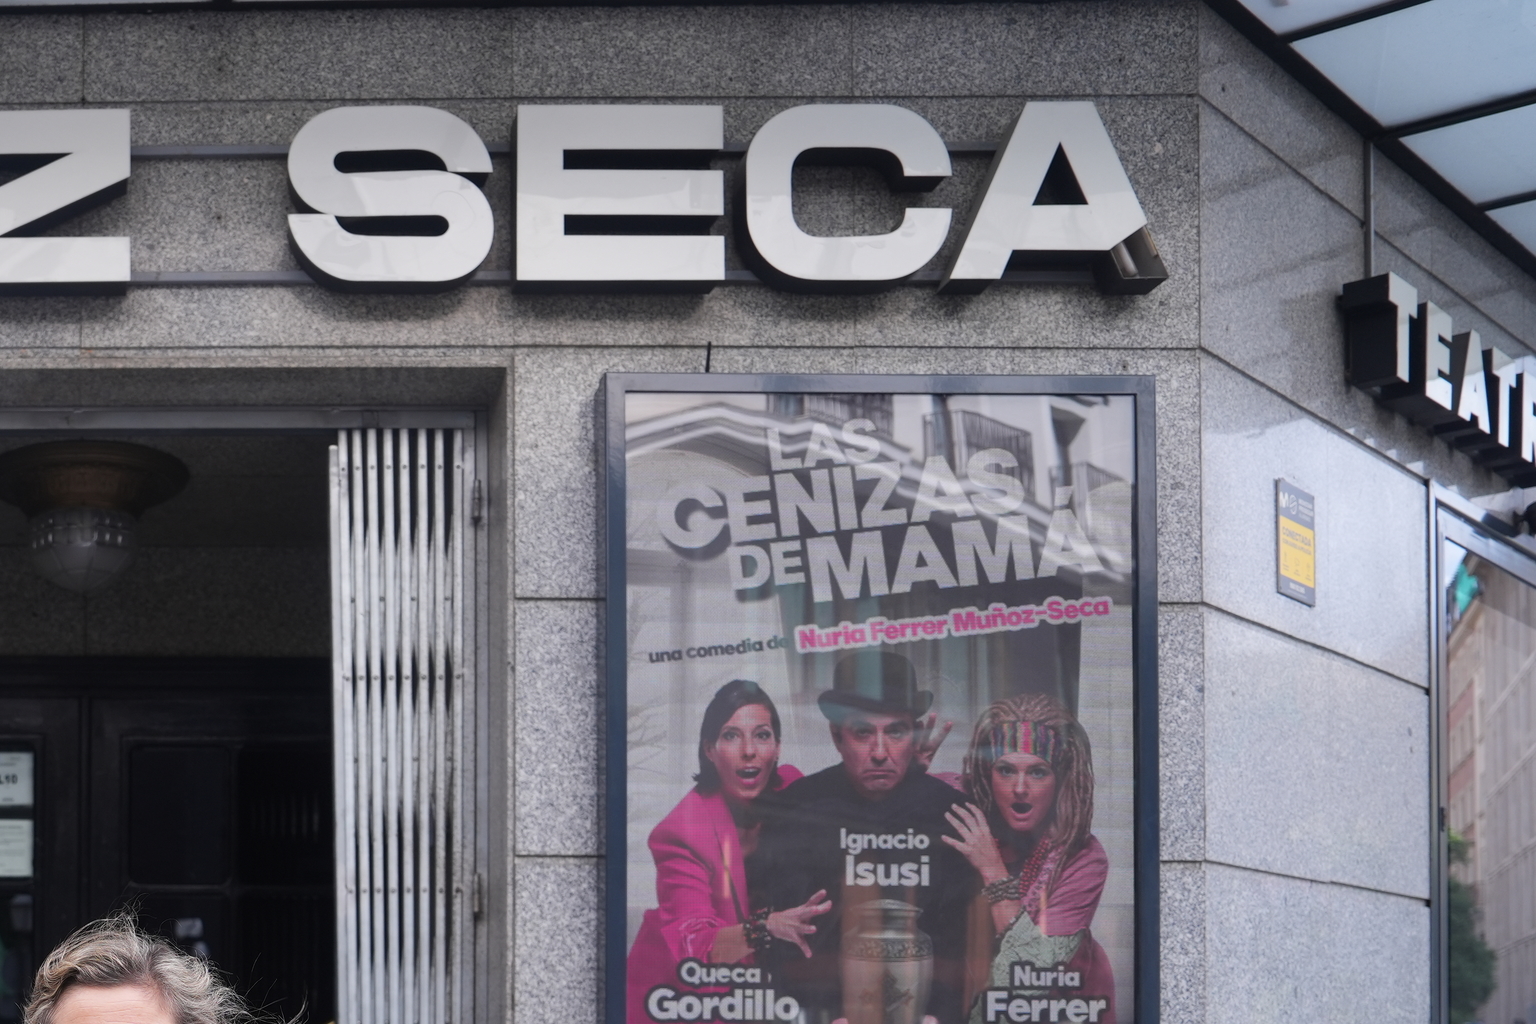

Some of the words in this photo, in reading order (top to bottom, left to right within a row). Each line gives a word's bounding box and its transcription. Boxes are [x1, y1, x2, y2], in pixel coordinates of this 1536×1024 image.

[288, 101, 1168, 281] SECA
[768, 418, 880, 470] LAS
[660, 448, 1024, 549] CENIZAS
[728, 539, 805, 591] DE
[805, 486, 1106, 603] MAMÁ
[648, 649, 683, 664] una
[686, 638, 763, 659] comedia
[767, 635, 788, 650] de
[799, 625, 865, 649] Nuria
[870, 618, 948, 641] Ferrer
[953, 599, 1110, 632] Muñoz-Seca
[840, 828, 929, 853] Ignacio
[846, 854, 930, 886] Isusi
[679, 962, 761, 986] Queca
[1013, 966, 1080, 988] Nuria
[648, 987, 799, 1021] Gordillo
[986, 990, 1106, 1023] Ferrer
